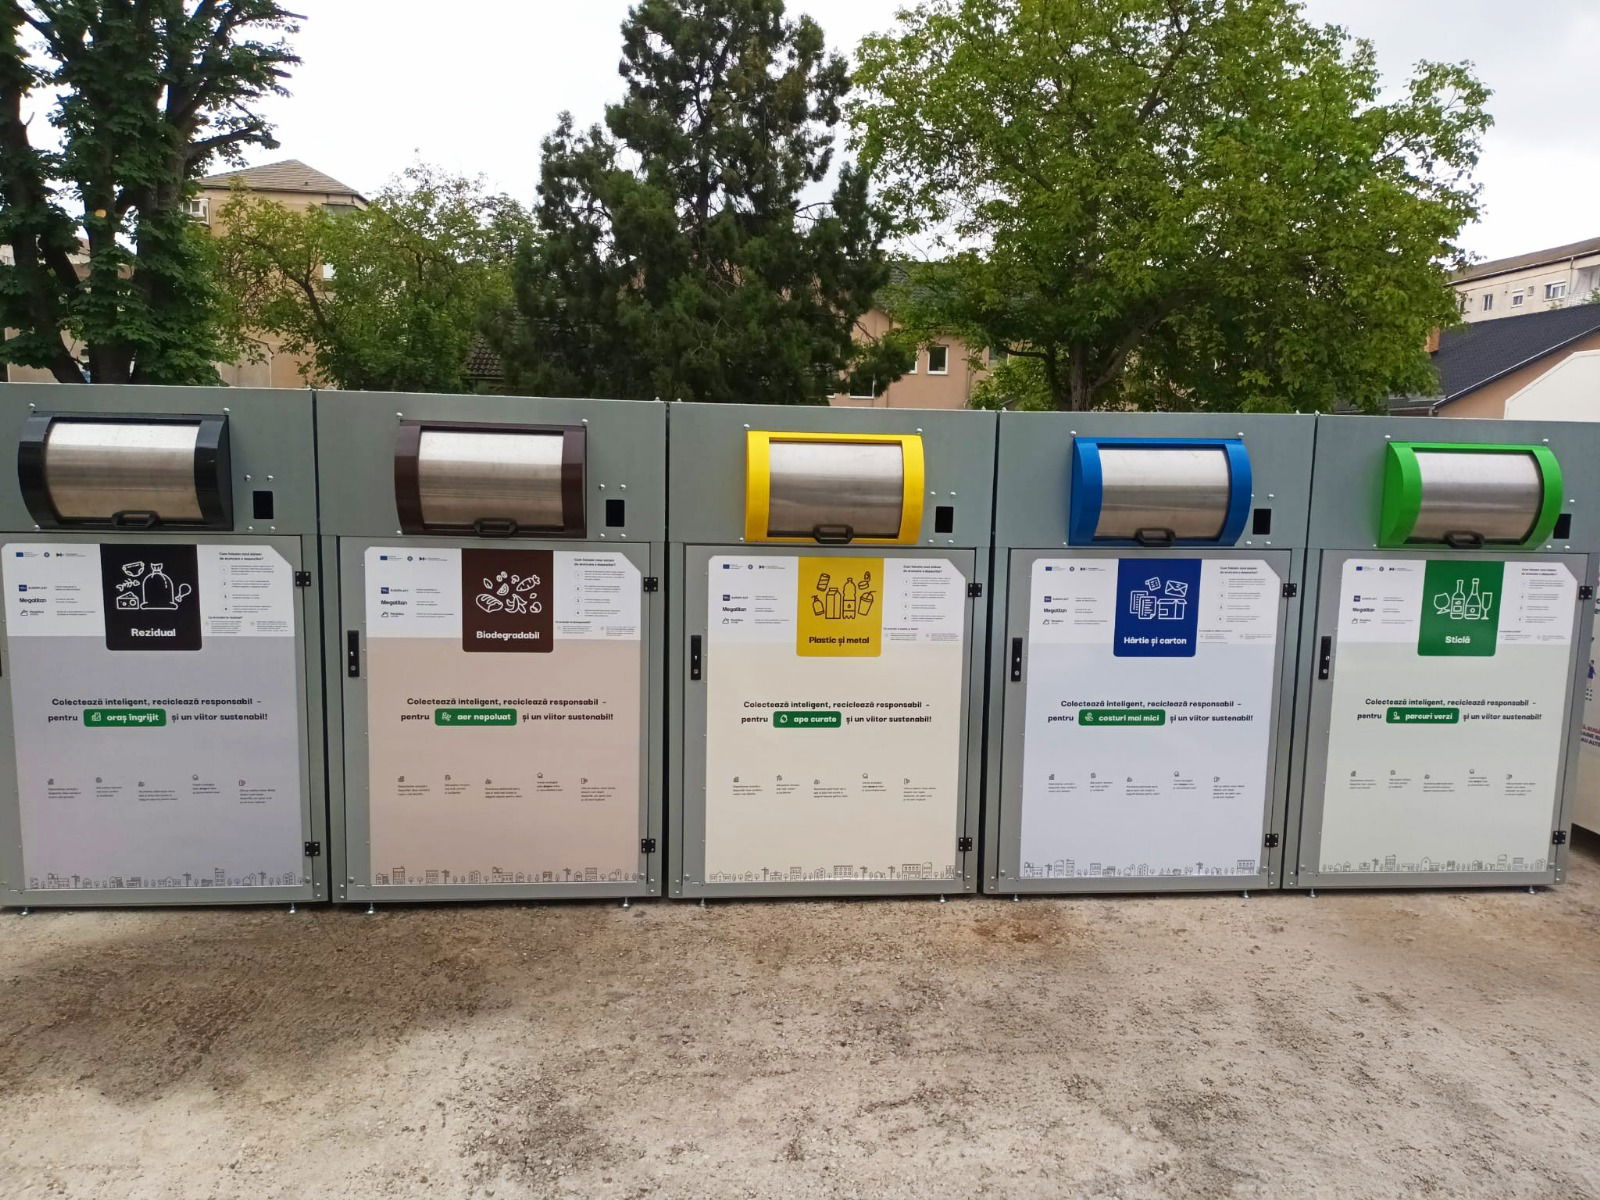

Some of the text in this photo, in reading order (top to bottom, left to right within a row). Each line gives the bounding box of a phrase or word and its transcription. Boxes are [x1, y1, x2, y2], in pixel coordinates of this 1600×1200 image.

[131, 627, 176, 638] Rezidual
[476, 630, 540, 641] Biodegradabil
[809, 636, 870, 647] Plastic și metal
[1123, 636, 1187, 647] Hârtie și carton
[1445, 636, 1470, 644] Sticlă
[52, 697, 102, 705] Colectează
[105, 697, 150, 707] inteligent,
[152, 697, 199, 705] reciclează
[201, 697, 252, 707] responsabil
[458, 698, 501, 707] inteligent,
[550, 698, 598, 707] responsabil
[791, 701, 831, 710] inteligent,
[876, 701, 922, 710] responsabil
[1107, 700, 1146, 708] inteligent,
[1189, 700, 1234, 709] responsabil
[1408, 698, 1445, 706] inteligent,
[1487, 699, 1529, 707] responsabil
[48, 714, 78, 723] pentru
[128, 713, 159, 723] îngrijit
[172, 713, 179, 723] și
[194, 713, 217, 721] viitor
[220, 713, 268, 721] sustenabil!
[401, 714, 430, 722] pentru
[474, 714, 511, 723] nepoluat
[522, 714, 530, 723] și
[741, 716, 768, 724] pentru
[846, 716, 853, 725] și
[866, 715, 887, 723] viitor
[889, 715, 932, 723] sustenabil!
[1098, 714, 1126, 722] costuri
[1143, 714, 1160, 722] mici
[1170, 715, 1176, 724] și
[1405, 713, 1433, 721] parcuri
[1463, 713, 1470, 722] și
